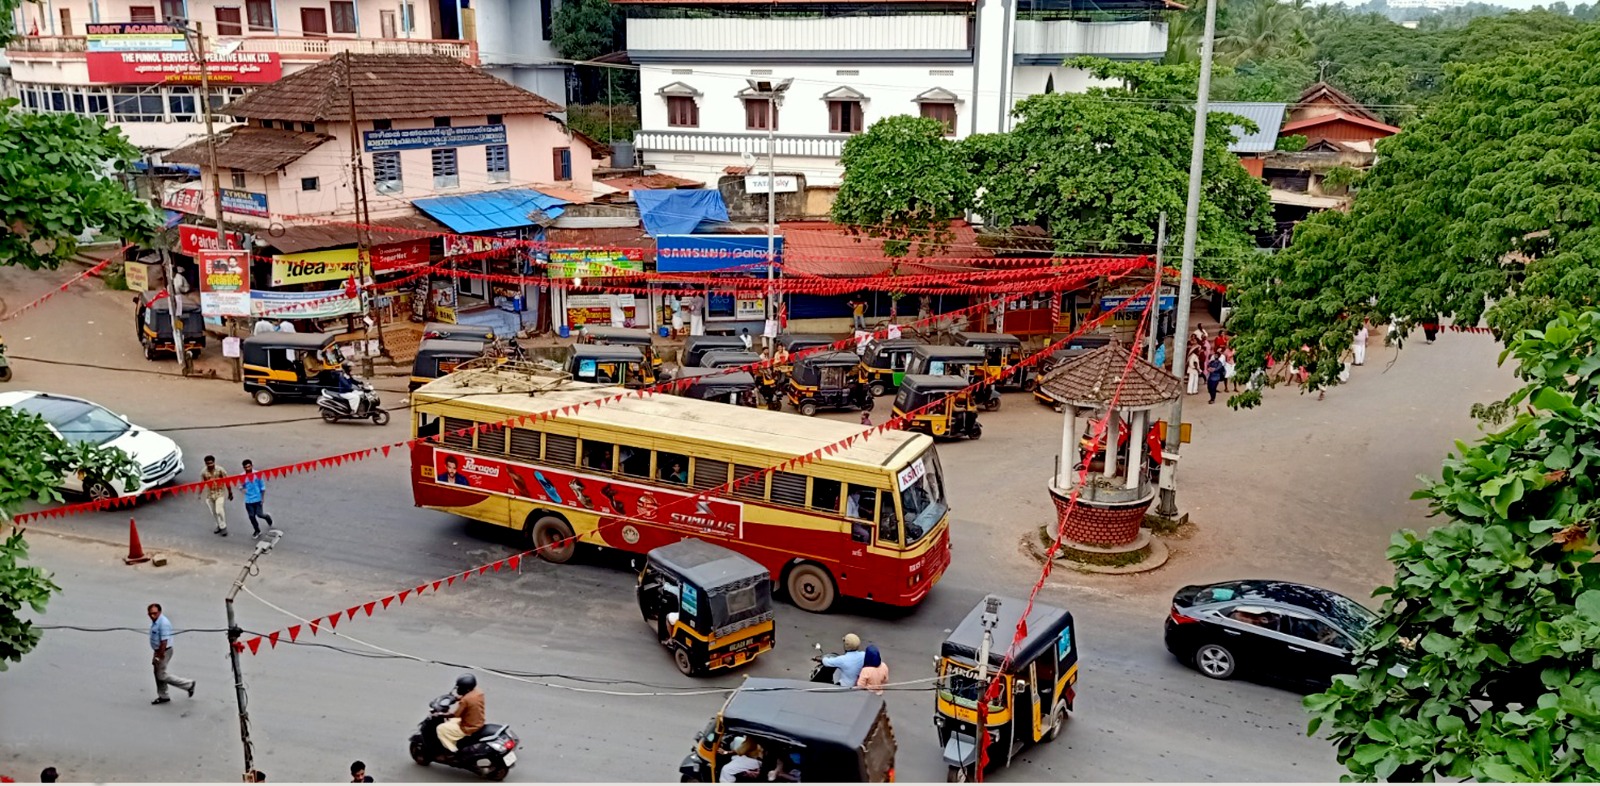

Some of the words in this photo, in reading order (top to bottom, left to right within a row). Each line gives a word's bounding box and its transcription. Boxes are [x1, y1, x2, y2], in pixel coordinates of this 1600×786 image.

[88, 25, 121, 34] DIGIT
[121, 53, 135, 62] THE
[135, 53, 161, 62] PUNNOL
[162, 53, 189, 62] SERVICE
[238, 53, 257, 62] BANK
[775, 179, 789, 188] sky
[198, 233, 219, 251] airtel
[662, 247, 727, 259] SAMSUNG
[462, 457, 500, 478] Paragon
